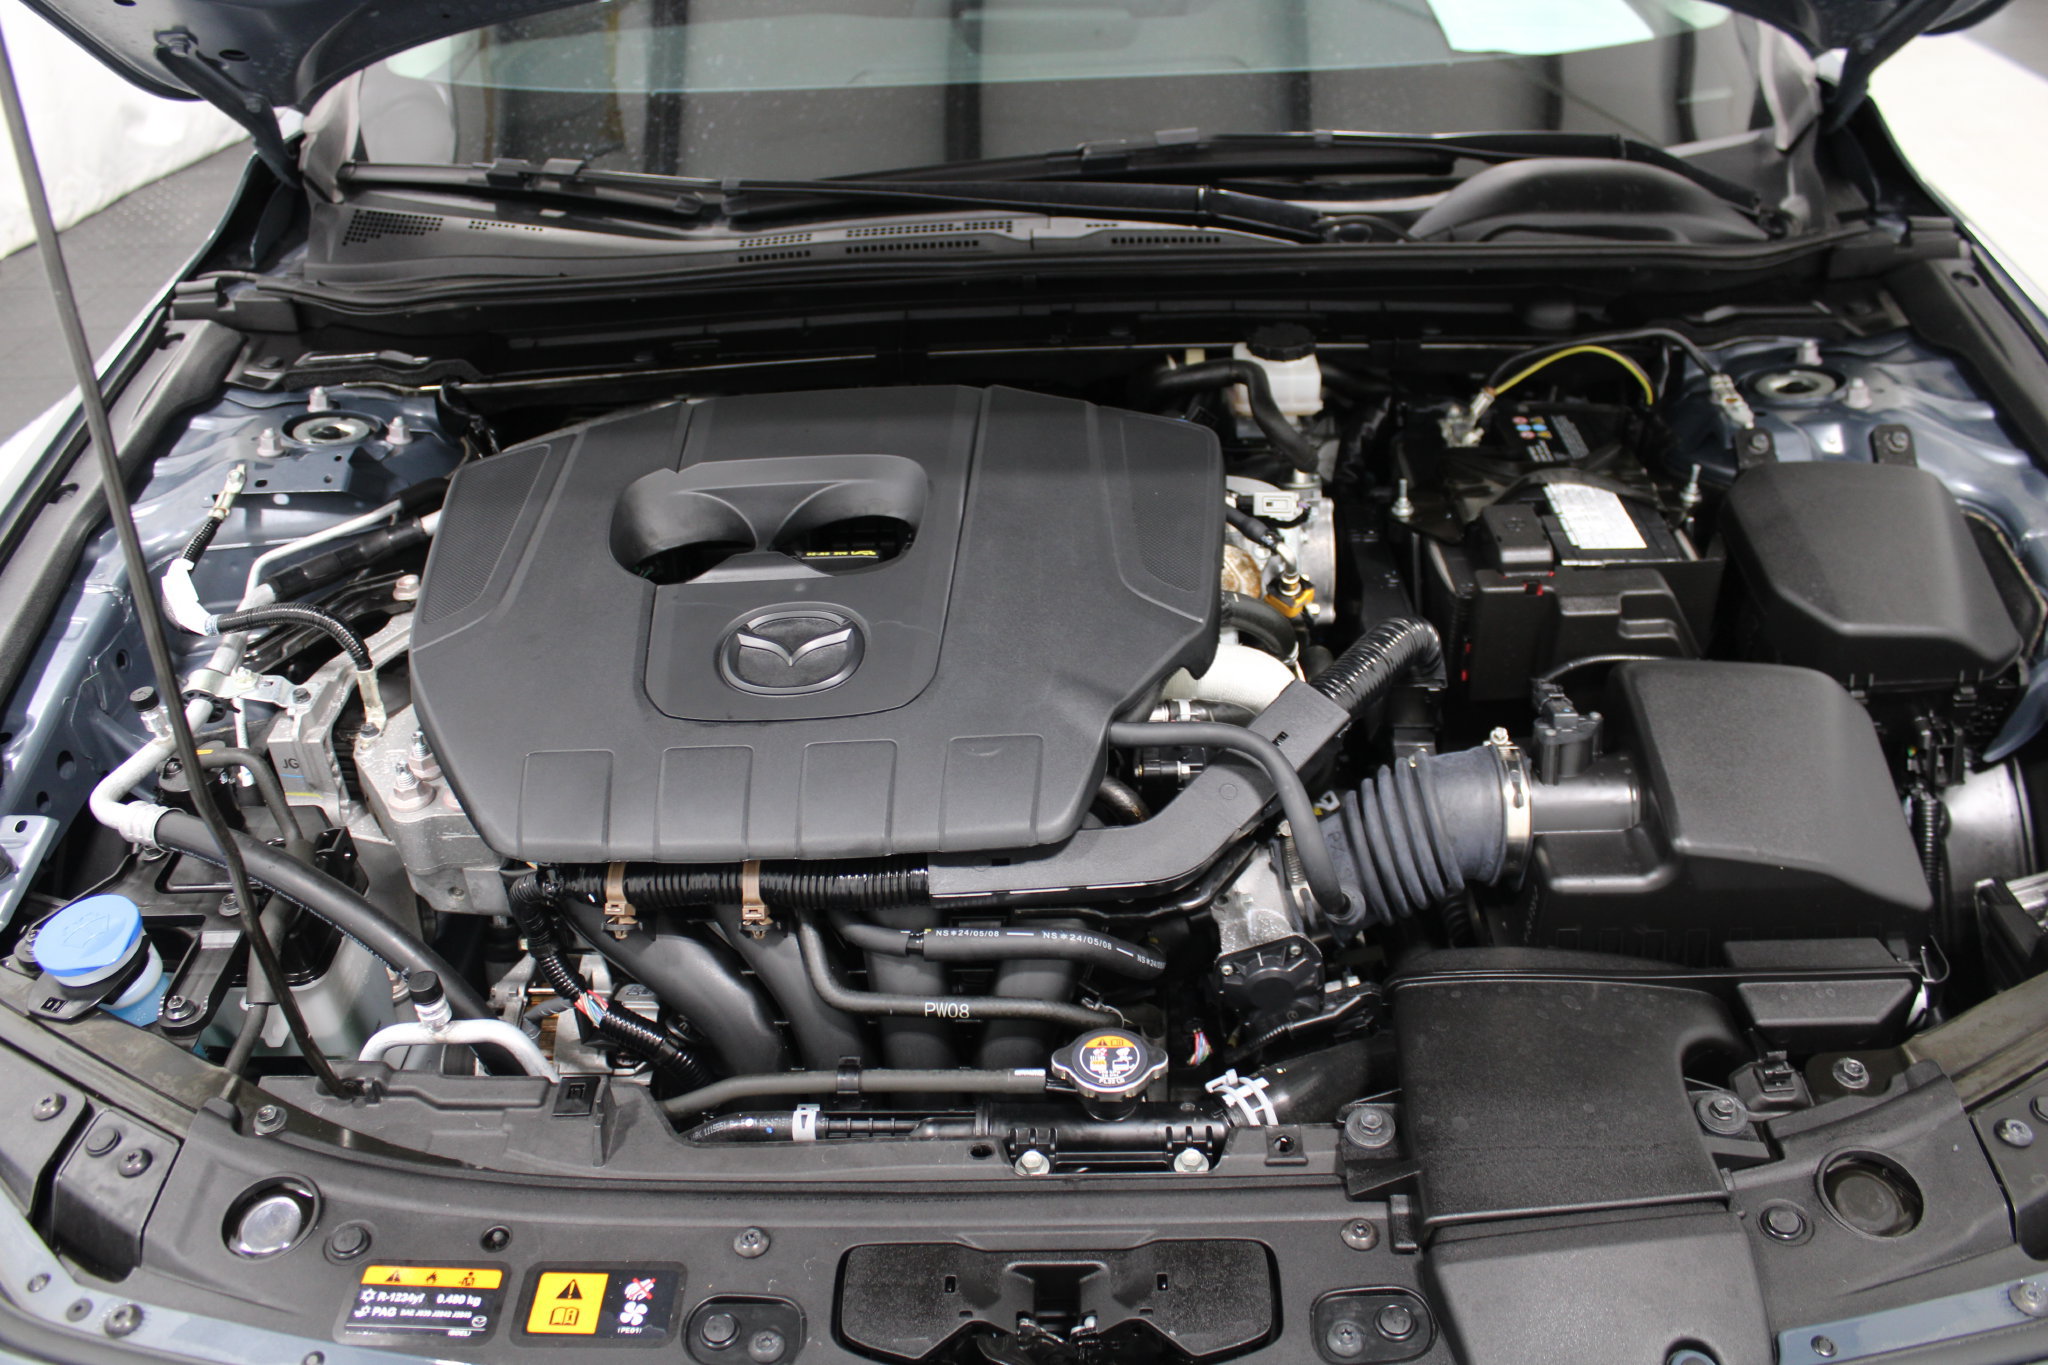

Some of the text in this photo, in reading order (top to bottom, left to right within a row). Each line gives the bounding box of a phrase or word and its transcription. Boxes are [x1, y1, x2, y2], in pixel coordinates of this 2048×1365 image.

[924, 1001, 970, 1019] PW08
[376, 1291, 426, 1305] R-1234yf
[467, 1294, 482, 1308] kg
[371, 1306, 397, 1317] PAG
